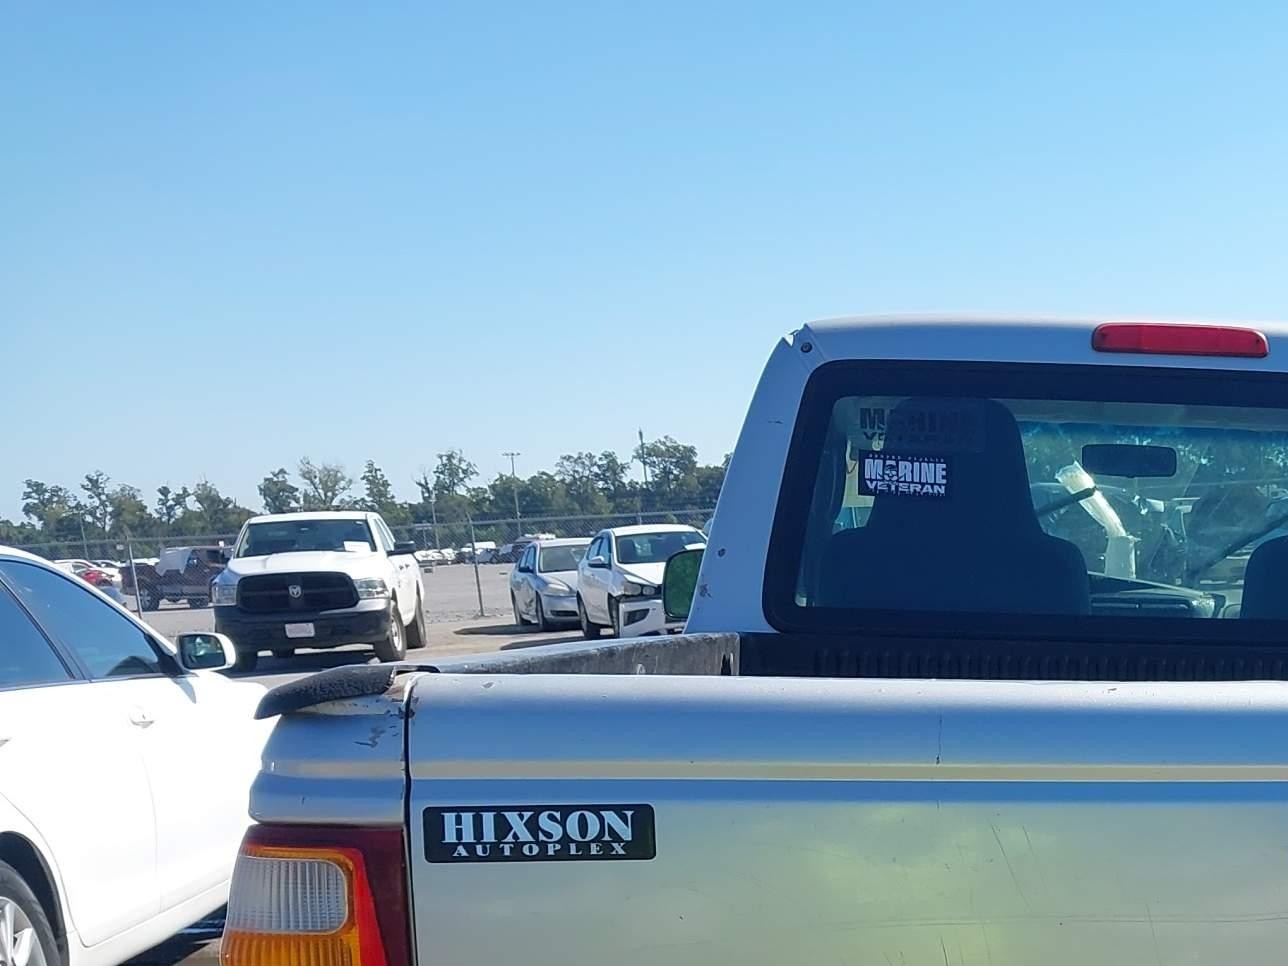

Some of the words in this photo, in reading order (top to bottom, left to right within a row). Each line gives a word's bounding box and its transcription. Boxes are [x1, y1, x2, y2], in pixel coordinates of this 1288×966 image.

[865, 480, 946, 495] VETERAN
[440, 810, 635, 843] HIXSON
[451, 842, 627, 857] AUTOPLEX
